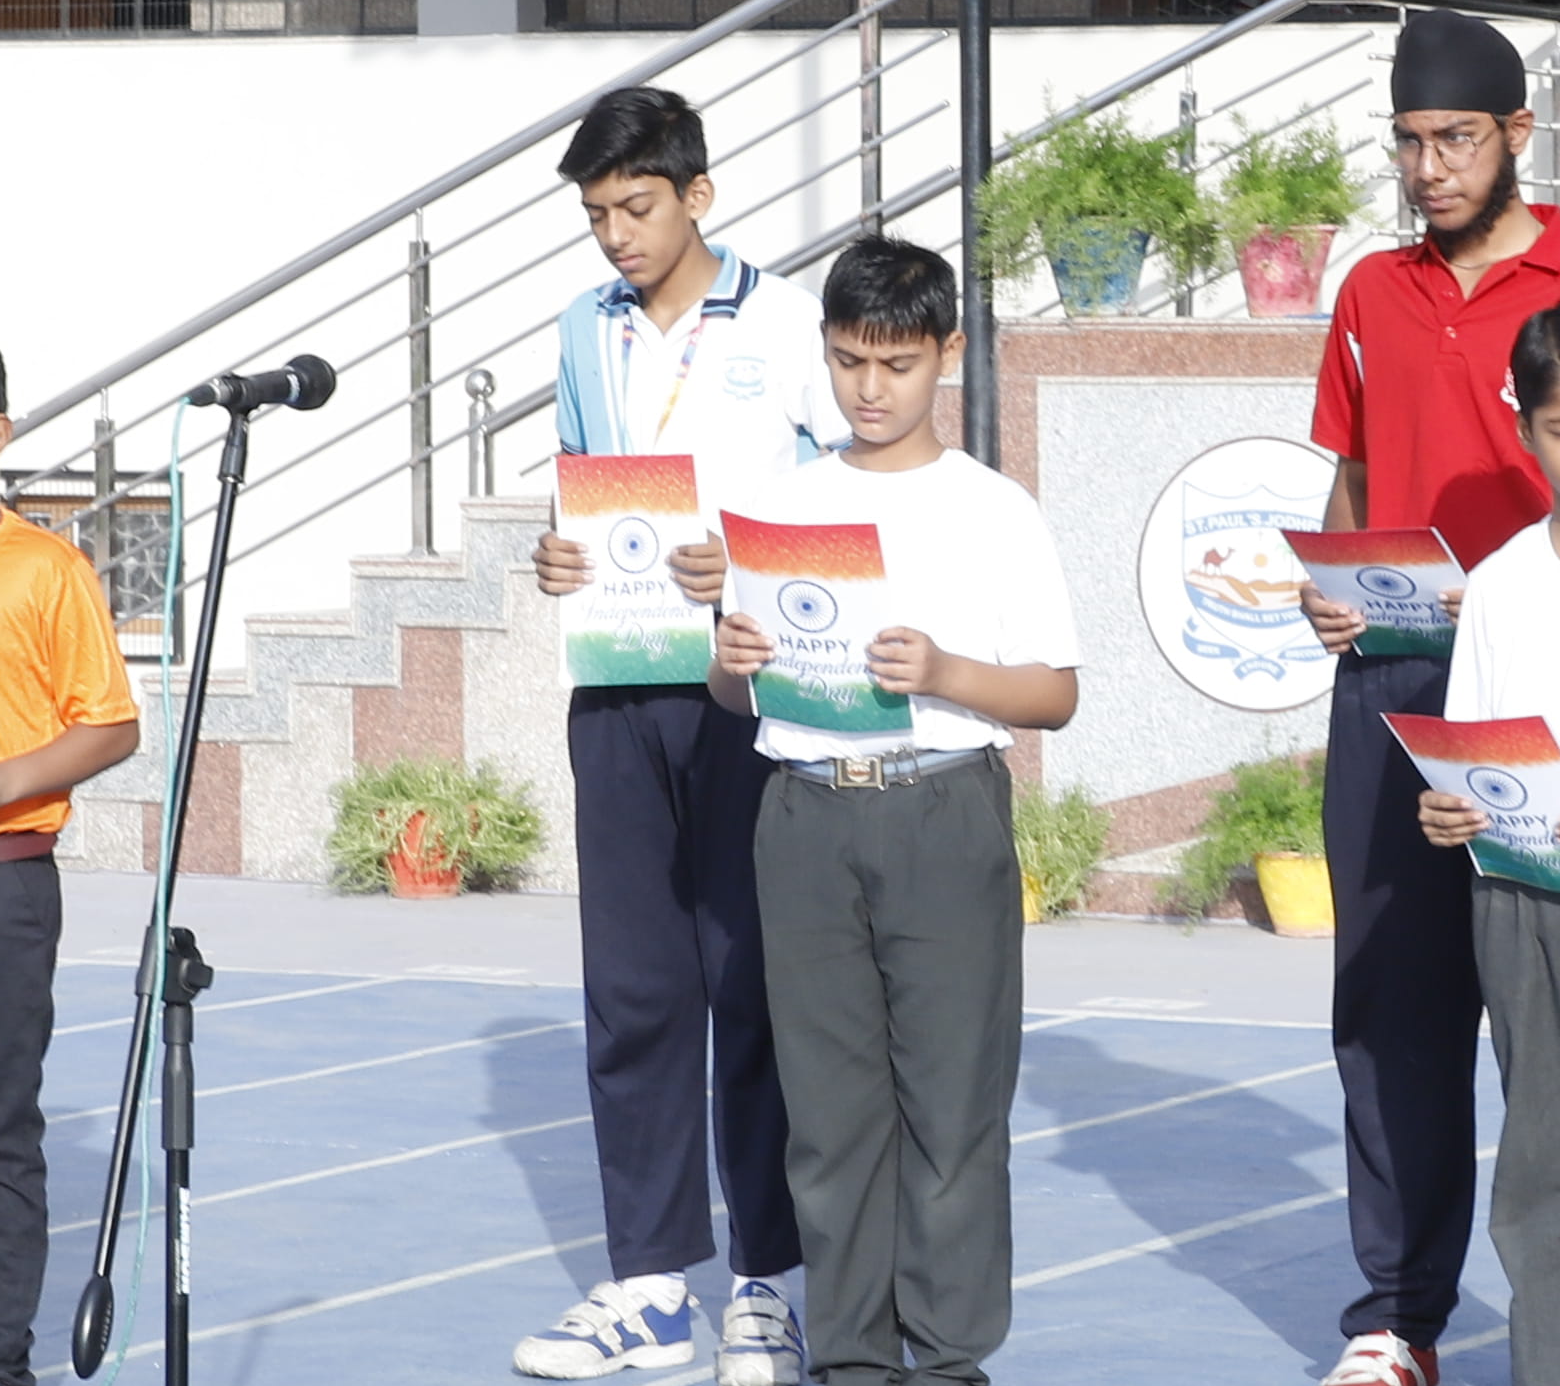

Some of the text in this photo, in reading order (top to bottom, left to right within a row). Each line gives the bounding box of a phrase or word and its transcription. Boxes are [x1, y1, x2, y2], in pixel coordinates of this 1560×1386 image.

[1267, 515, 1322, 532] JODHP
[604, 580, 667, 596] HAPPY
[1365, 599, 1436, 614] HAPPY
[612, 621, 674, 662] Day
[778, 633, 851, 654] HAPPY
[796, 675, 863, 713] Day
